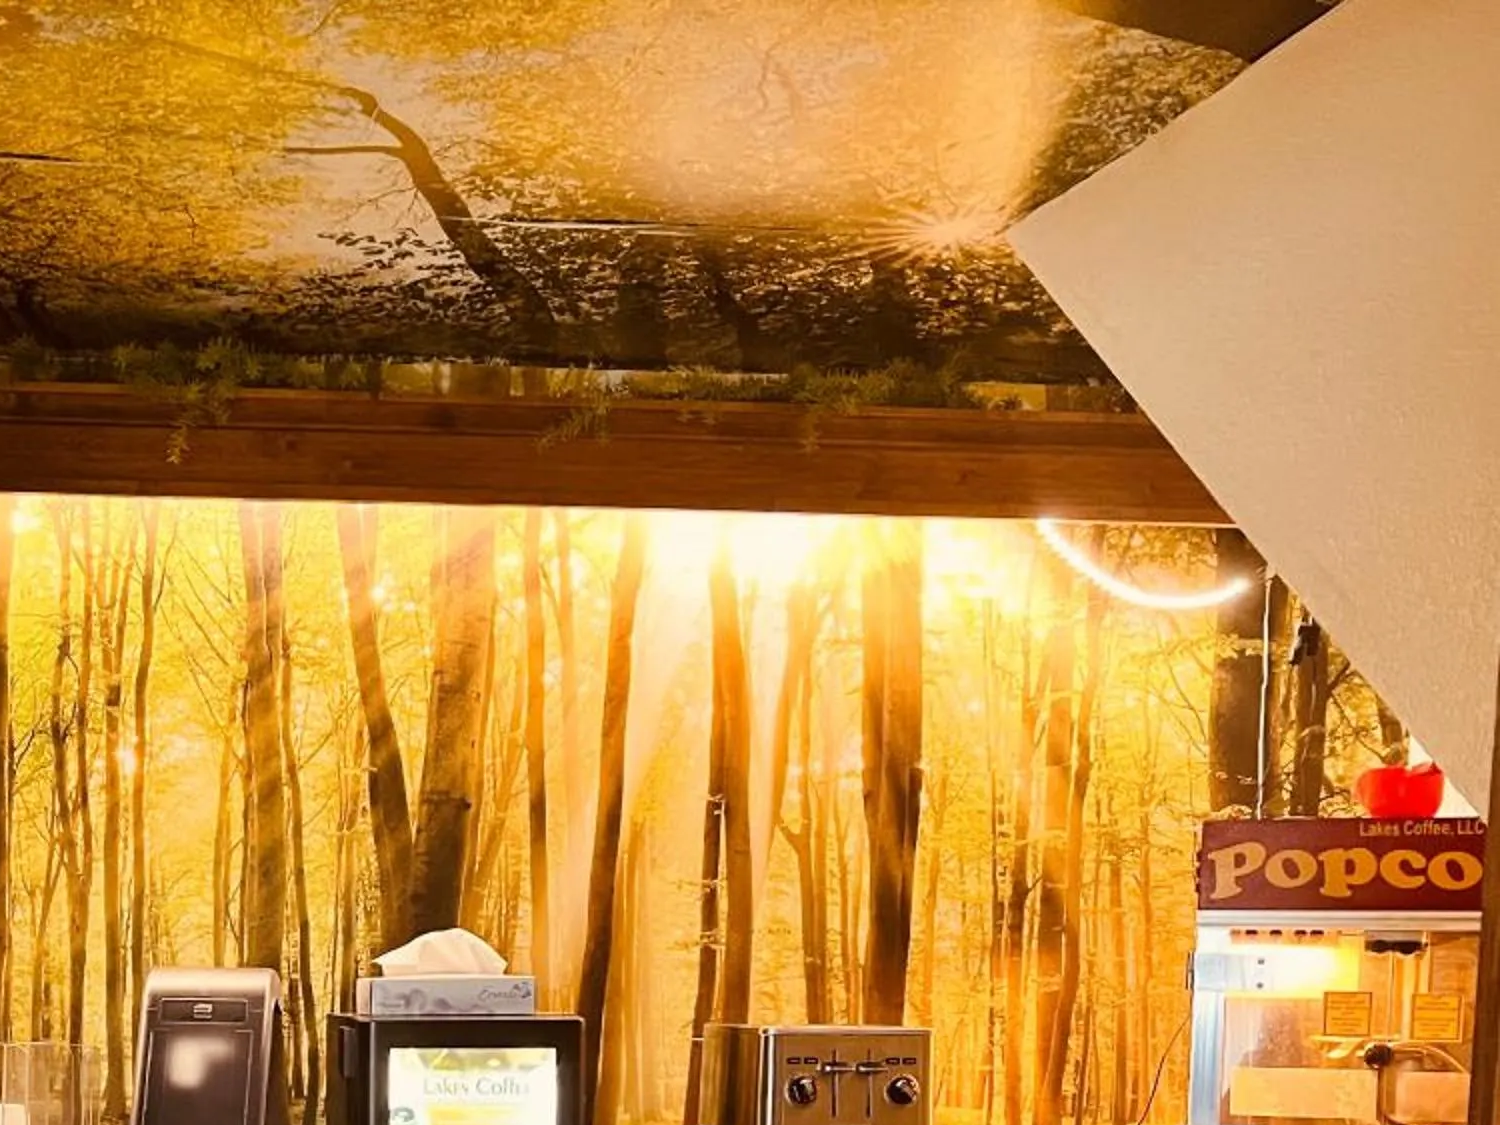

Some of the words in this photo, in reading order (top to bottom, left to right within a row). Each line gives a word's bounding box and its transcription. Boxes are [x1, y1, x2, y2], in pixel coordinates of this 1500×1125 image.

[1359, 820, 1400, 837] Lakes
[1457, 818, 1485, 835] LLC
[1208, 841, 1484, 899] Popco
